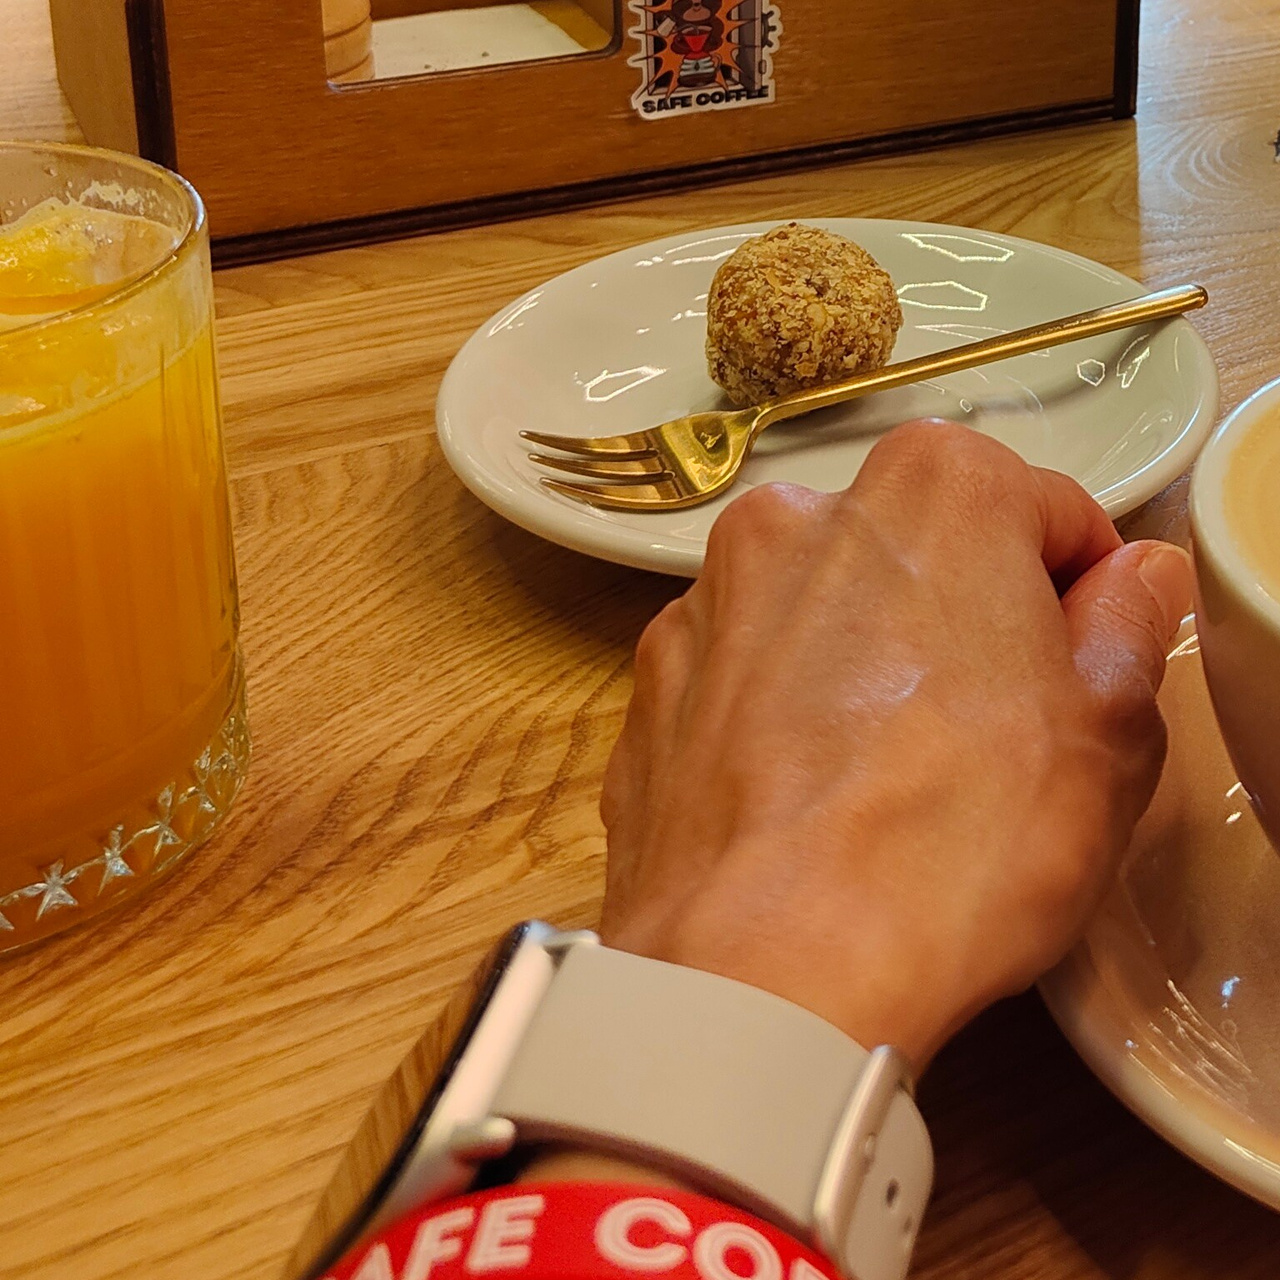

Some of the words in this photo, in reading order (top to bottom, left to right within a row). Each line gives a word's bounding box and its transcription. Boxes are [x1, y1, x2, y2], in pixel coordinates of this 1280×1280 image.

[642, 94, 692, 114] SAFE
[323, 1194, 546, 1280] AFE
[593, 1196, 832, 1280] CO
